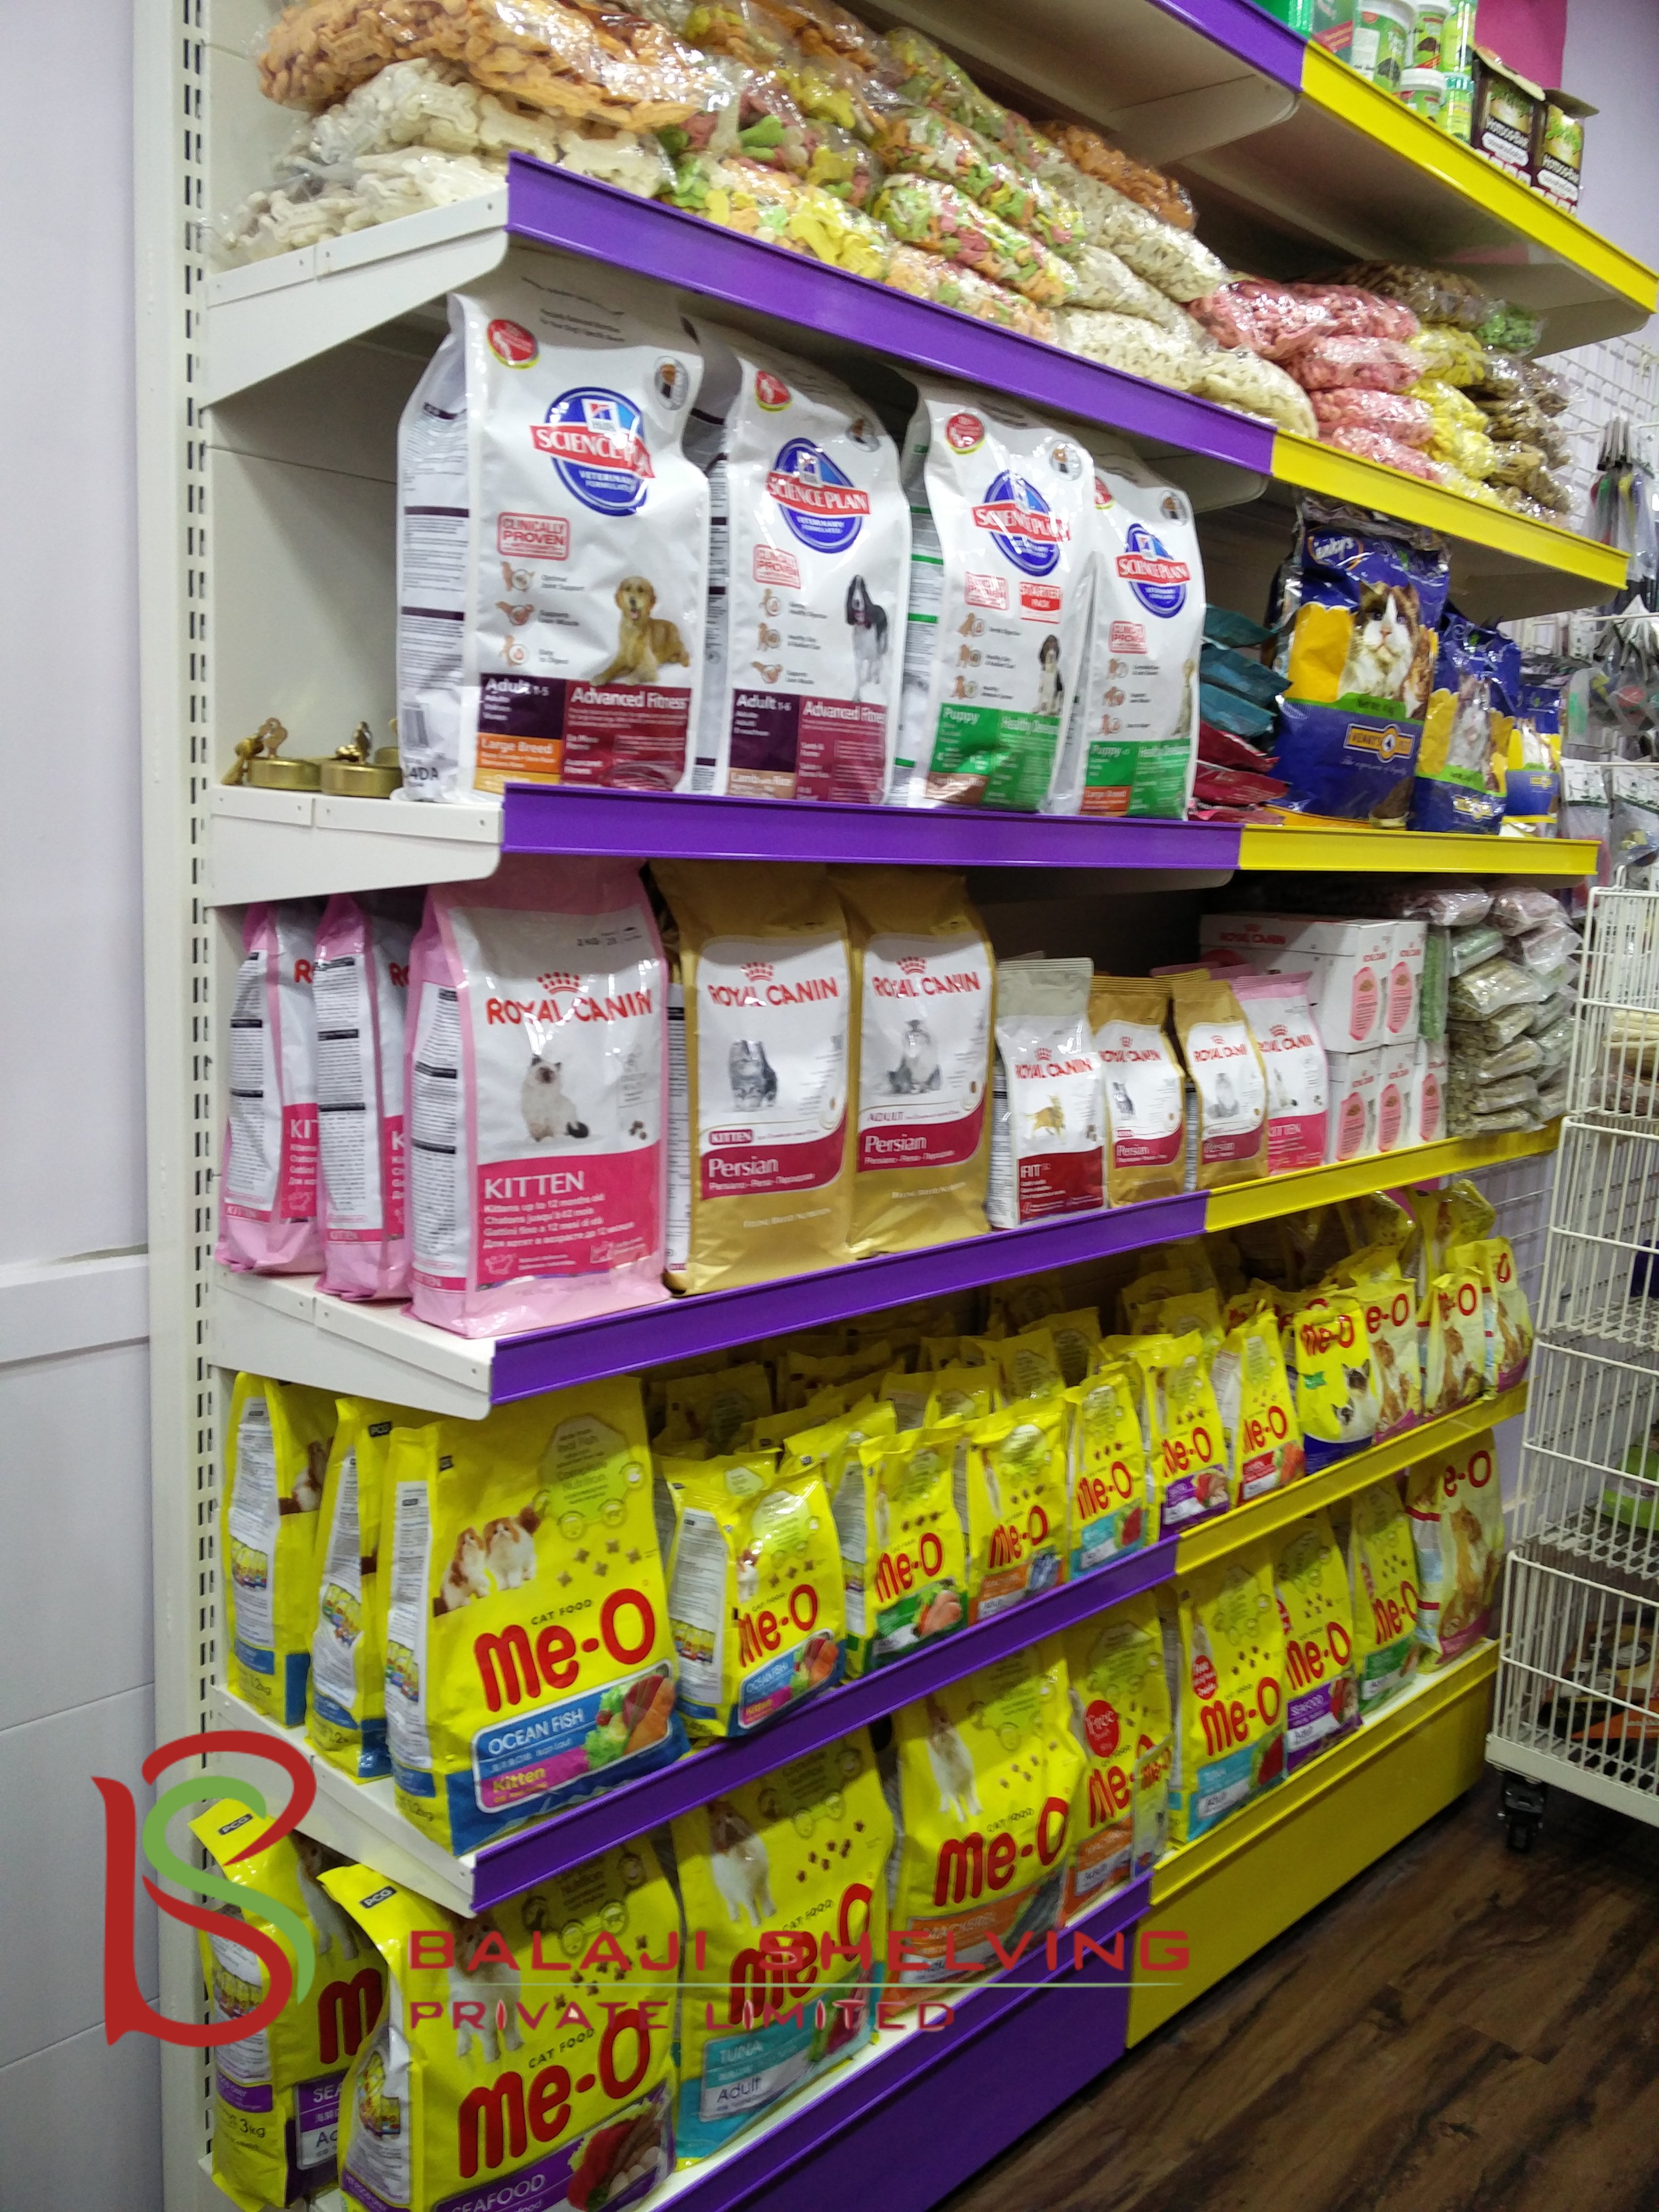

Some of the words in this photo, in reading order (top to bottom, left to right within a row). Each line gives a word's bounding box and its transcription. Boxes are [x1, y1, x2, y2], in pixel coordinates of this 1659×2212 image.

[536, 429, 622, 459] SCIENCE
[766, 480, 825, 508] SCIENCE
[825, 491, 868, 511] PLAN
[503, 530, 564, 546] PROVEN
[485, 678, 530, 694] Adult
[571, 687, 645, 708] Advanced
[736, 694, 777, 710] Adult
[803, 701, 860, 720] Advanced
[943, 707, 980, 726] Puppy
[481, 737, 516, 753] Large
[518, 742, 554, 754] Breed
[708, 985, 766, 1007] ROYAL
[767, 976, 839, 1006] CANIN
[922, 972, 981, 996] CANIN
[485, 997, 569, 1026] ROYAL
[573, 989, 654, 1023] CANIN
[711, 1131, 751, 1143] KITTEN
[865, 1133, 927, 1153] Persian
[709, 1156, 779, 1178] Persian
[484, 1171, 585, 1199] KITTEN
[1366, 1293, 1410, 1334] e-O
[1444, 1449, 1493, 1498] e-O
[531, 1610, 554, 1625] CAT
[559, 1599, 593, 1616] FOOD
[488, 1721, 549, 1754] OCEAN
[552, 1708, 584, 1732] FISH
[1085, 1709, 1116, 1736] Free
[493, 1767, 546, 1794] Kitten
[219, 1814, 252, 1835] PCG
[362, 1888, 395, 1907] PCG
[782, 1916, 804, 1932] CAT
[805, 1899, 834, 1921] FOOD
[529, 2048, 554, 2069] CAT
[559, 2028, 595, 2054] FOOD
[716, 2077, 762, 2103] Adult
